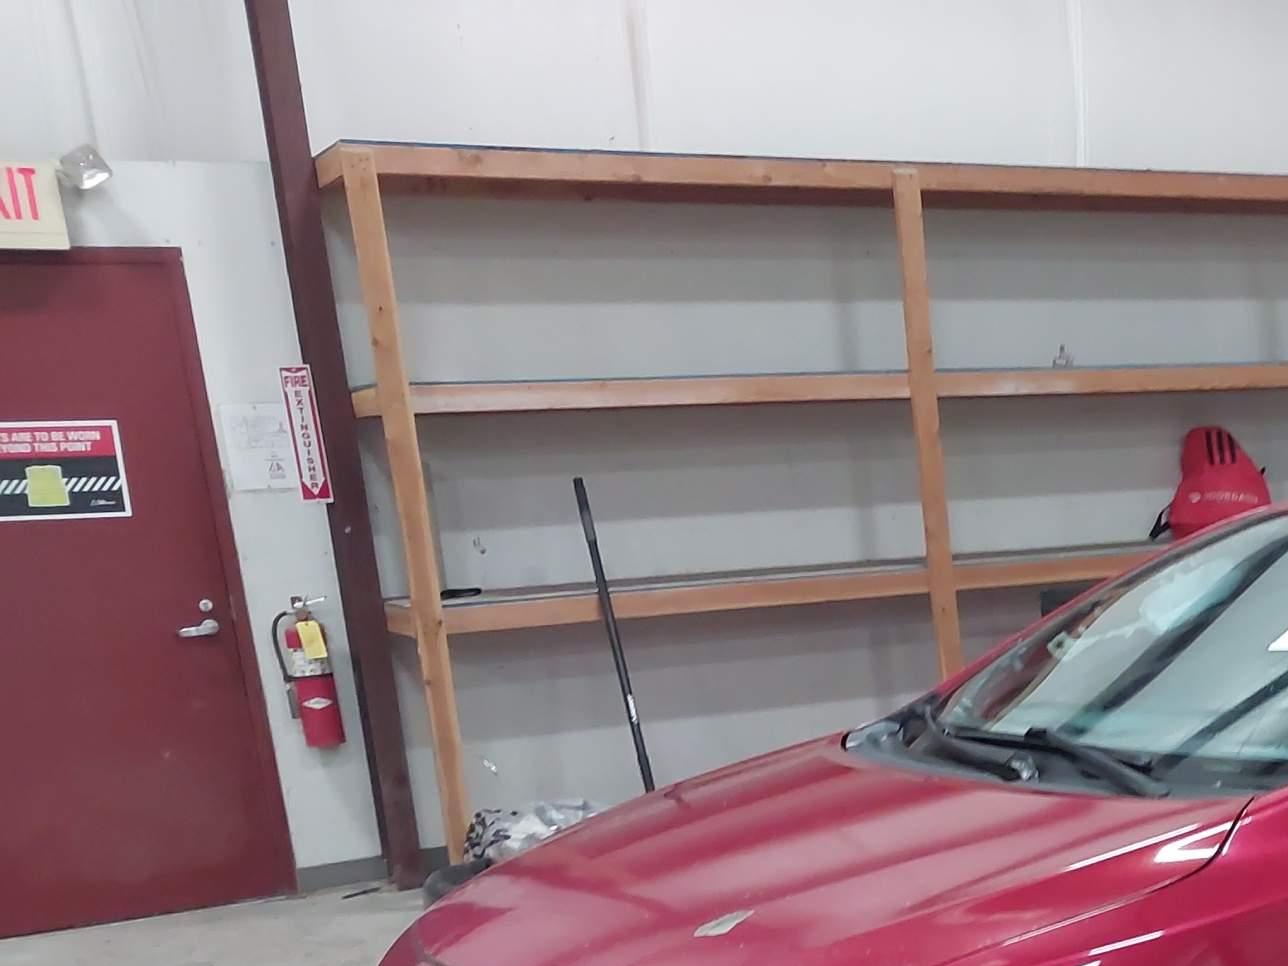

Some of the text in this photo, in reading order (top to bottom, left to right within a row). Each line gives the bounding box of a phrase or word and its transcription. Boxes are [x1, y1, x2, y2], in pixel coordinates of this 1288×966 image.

[0, 167, 40, 221] IT
[283, 375, 309, 388] FIRE
[11, 432, 33, 442] ARE
[33, 432, 49, 442] TO
[294, 390, 319, 489] EXTINGUISHER
[0, 443, 32, 453] YOND
